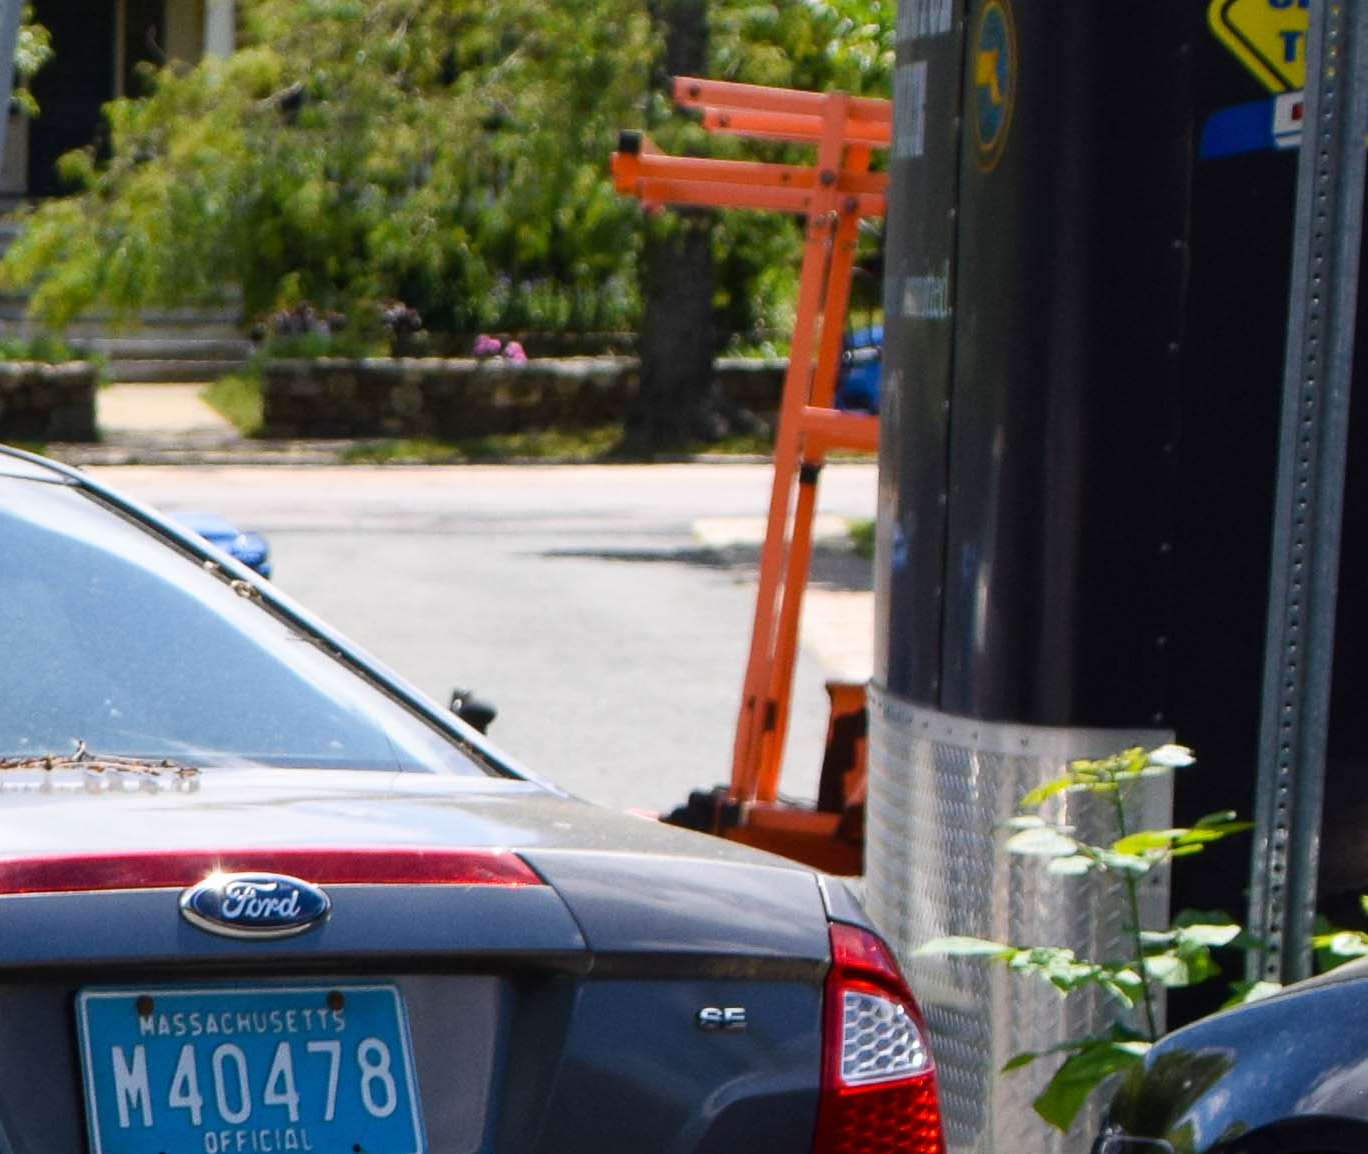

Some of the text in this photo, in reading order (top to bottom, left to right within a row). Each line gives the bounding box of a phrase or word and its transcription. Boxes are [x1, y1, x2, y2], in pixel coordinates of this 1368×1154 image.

[222, 881, 301, 919] Ford
[139, 1009, 346, 1037] MASSACHUSETTS
[699, 1007, 746, 1028] SE
[112, 1037, 397, 1128] M40478
[203, 1128, 313, 1154] OFFICIAL
